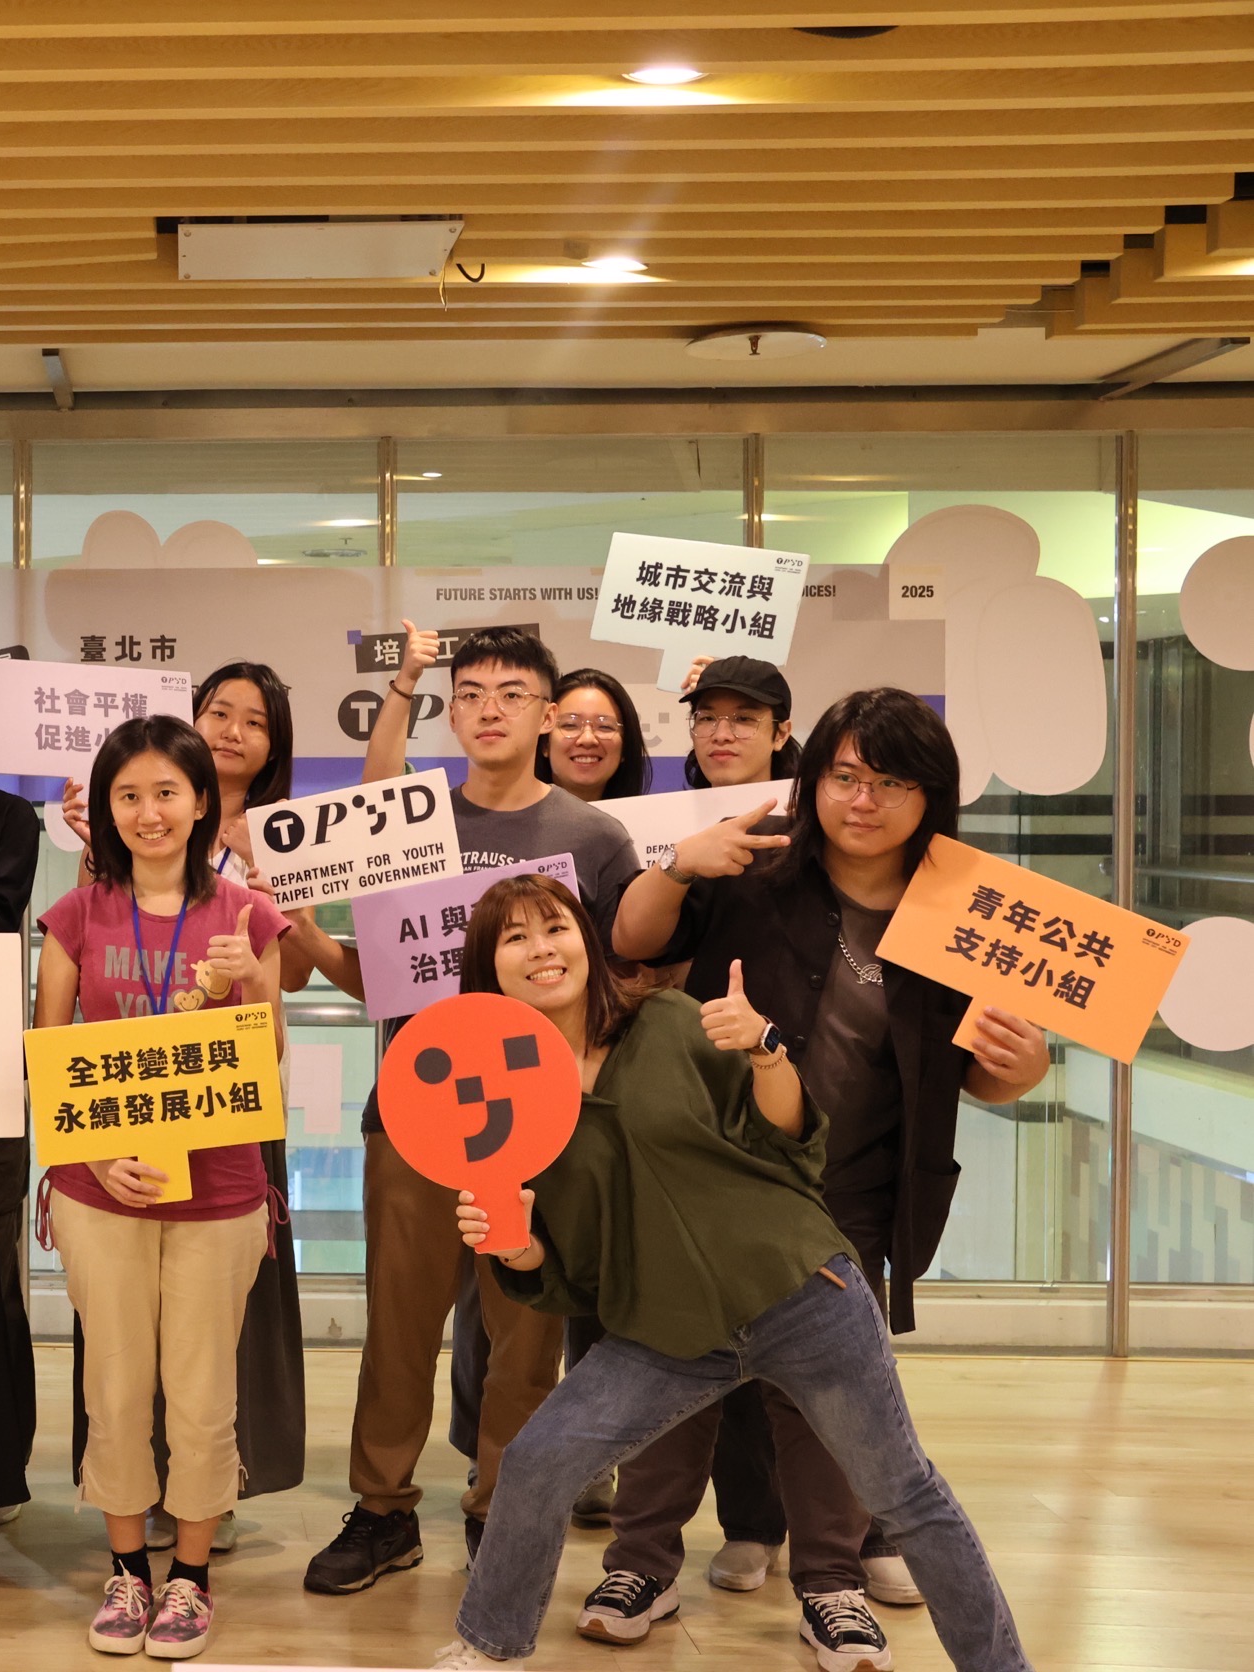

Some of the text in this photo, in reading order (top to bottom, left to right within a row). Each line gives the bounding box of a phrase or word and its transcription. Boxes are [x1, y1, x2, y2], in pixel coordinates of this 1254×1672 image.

[436, 587, 599, 601] FUTURE STARTS WITH US!
[635, 560, 775, 602] 城市交流與
[802, 585, 836, 598] ICES!
[901, 585, 934, 598] 2025
[611, 593, 777, 640] 地緣戰略小組
[80, 634, 177, 662] 臺北市
[34, 686, 148, 720] 社會平權
[34, 723, 103, 753] 促進
[271, 842, 445, 888] DEPARTMENT FOR YOUTH
[460, 851, 514, 867] TRAUSS
[274, 859, 447, 904] TAIPEI CITY GOVERNMENT
[399, 903, 478, 943] AI 與
[968, 884, 1114, 968] 青年公共
[104, 945, 188, 985] MAKE
[945, 925, 1096, 1010] 支持小組
[66, 1039, 240, 1088] 全球變遷與
[54, 1081, 263, 1134] 永續發展小組
